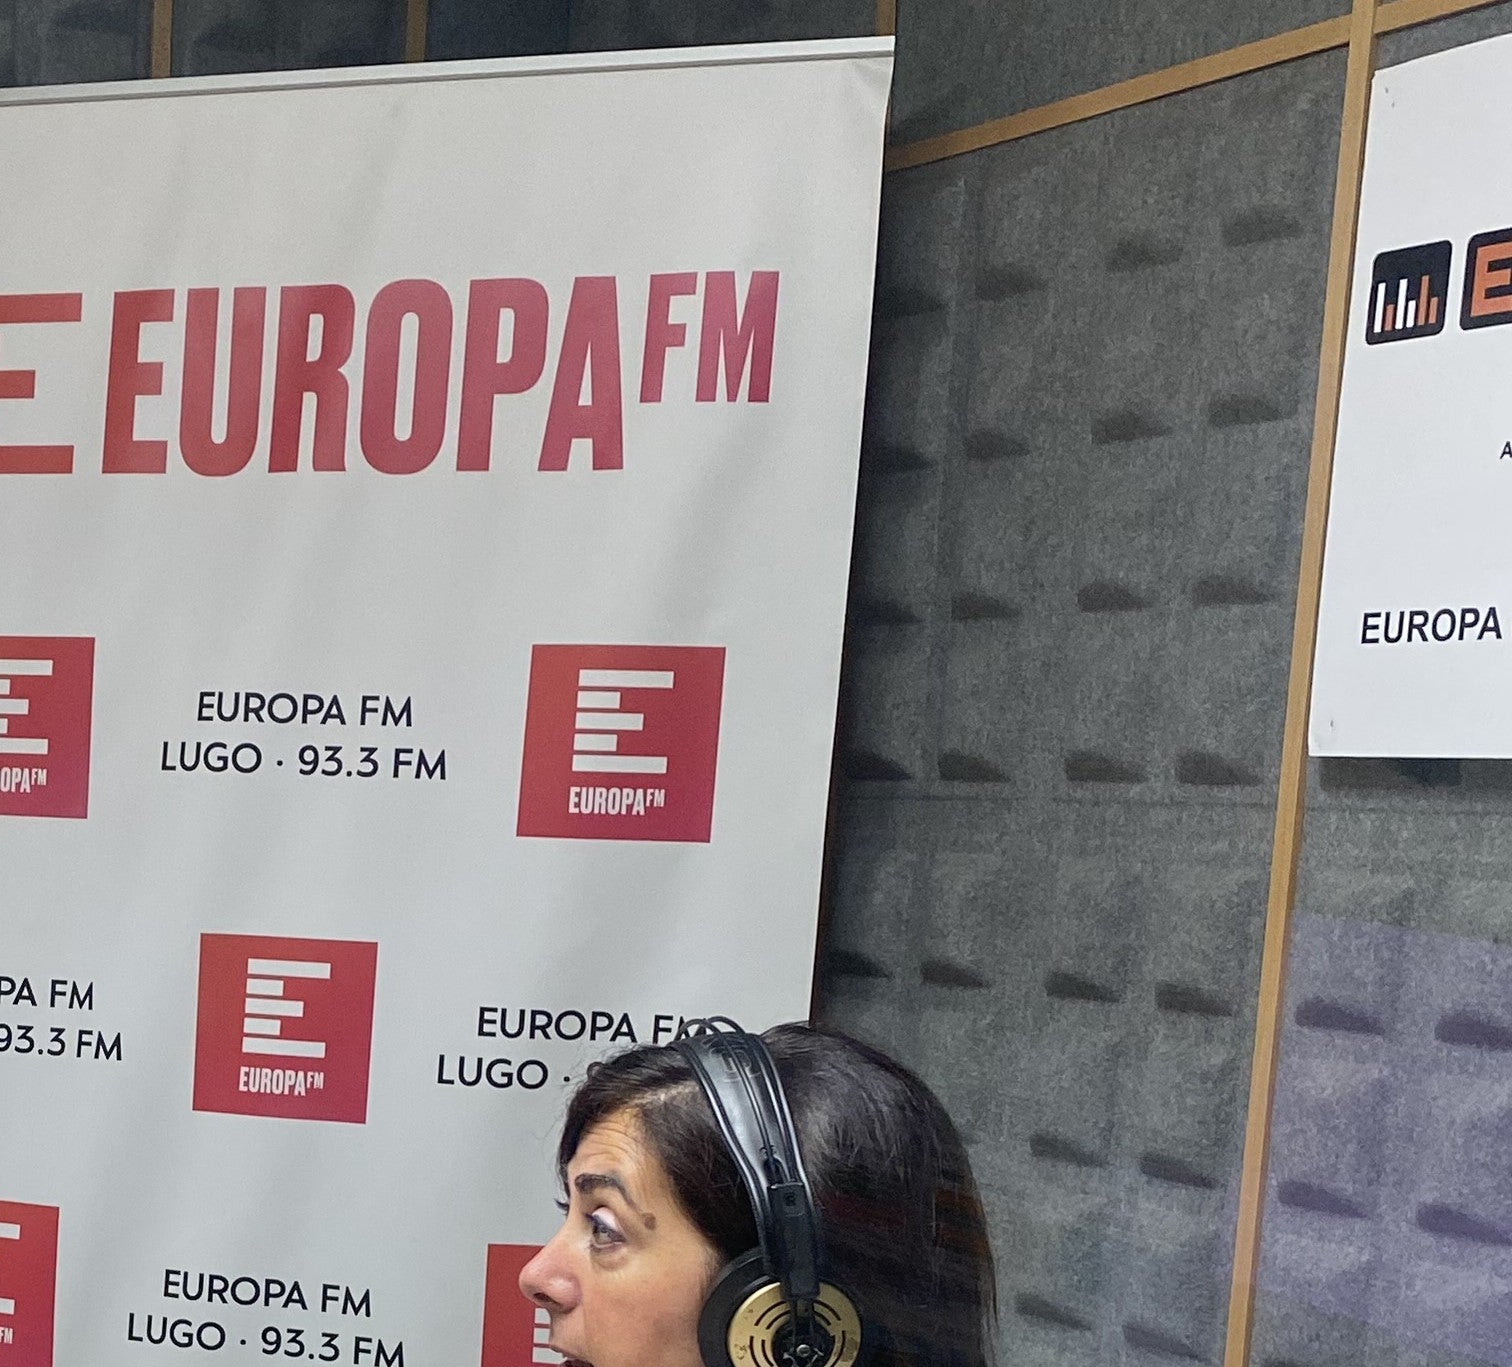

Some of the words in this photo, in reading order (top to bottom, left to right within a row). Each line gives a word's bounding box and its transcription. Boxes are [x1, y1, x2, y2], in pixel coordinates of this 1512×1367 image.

[1360, 606, 1503, 646] EUROPA
[197, 691, 347, 726] EUROPA
[359, 695, 413, 728] FM
[161, 741, 263, 774] LUGO
[298, 744, 379, 778] 93.3
[392, 747, 446, 781] FM
[49, 978, 94, 1011] FM
[477, 1006, 638, 1044] EUROPA
[76, 1029, 122, 1061] FM
[437, 1054, 549, 1090] LUGO
[163, 1268, 308, 1311] EUROPA
[320, 1283, 371, 1318] FM
[127, 1312, 226, 1351] LUGO
[261, 1326, 340, 1362] 93.3
